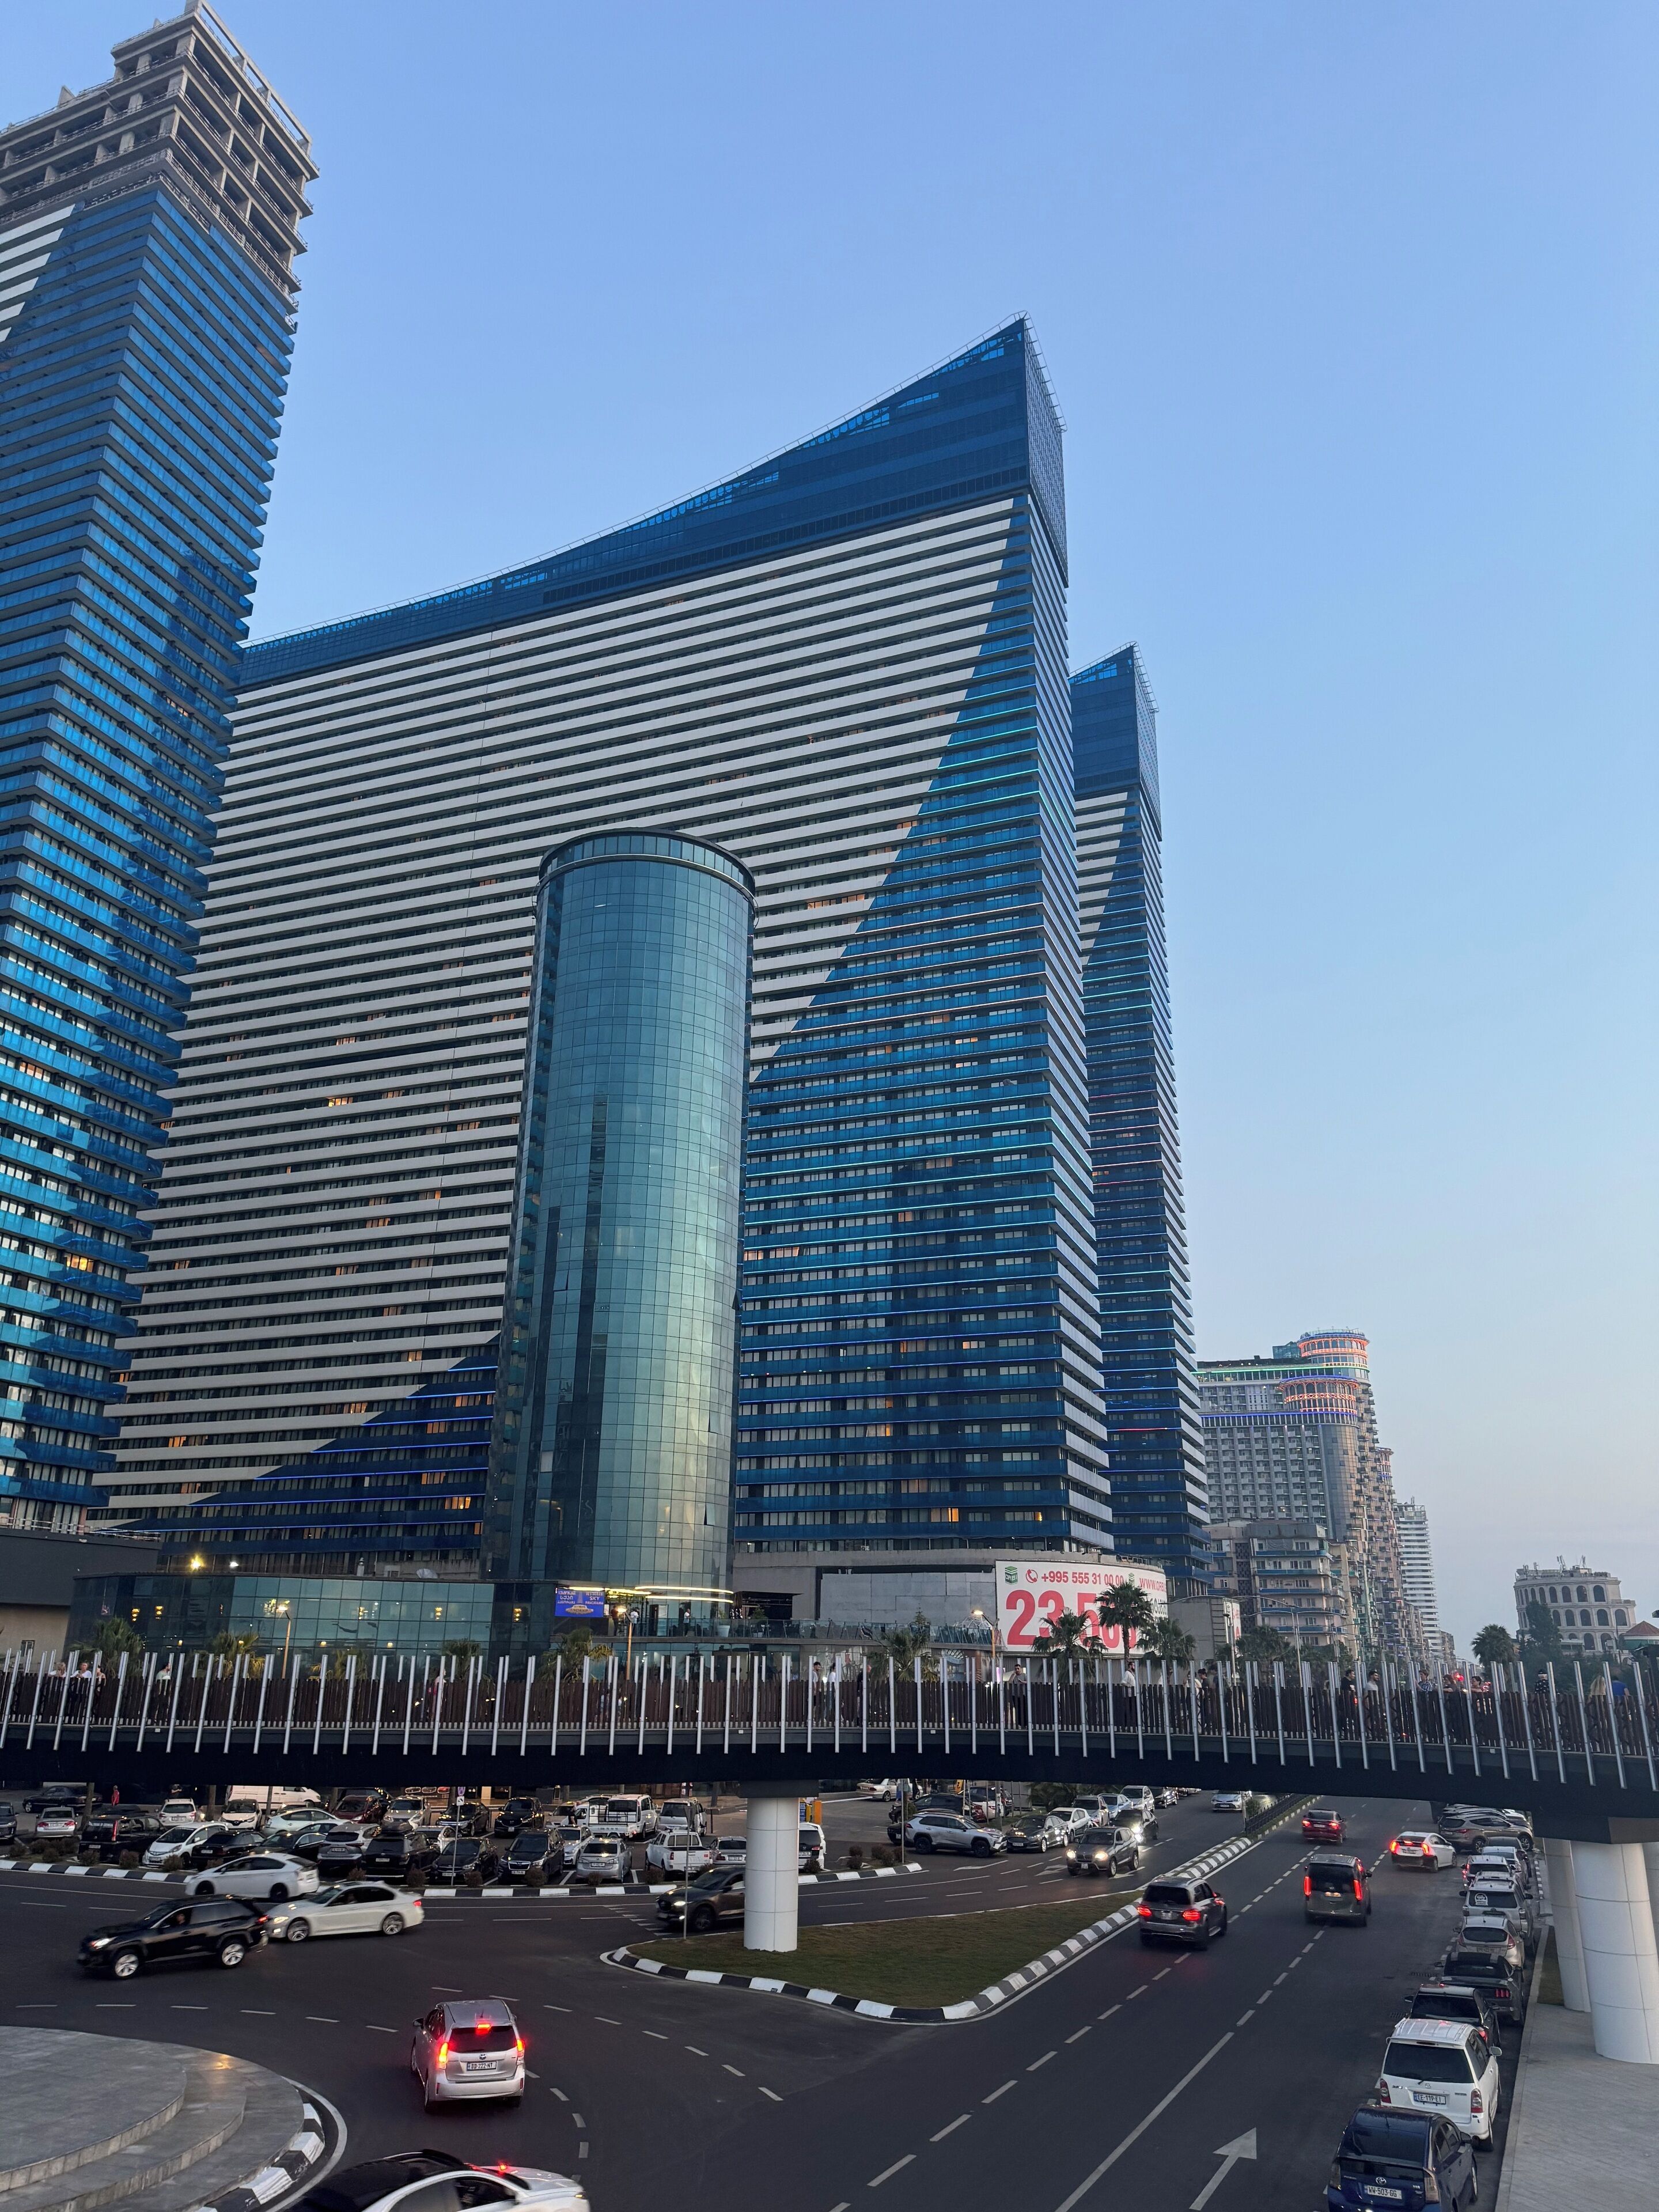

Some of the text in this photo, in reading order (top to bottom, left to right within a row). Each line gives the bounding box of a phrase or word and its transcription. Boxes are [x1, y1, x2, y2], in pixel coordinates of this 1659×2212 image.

[1041, 1571, 1069, 1582] +995
[1072, 1572, 1089, 1584] 555
[1092, 1573, 1101, 1585] 31
[1104, 1574, 1114, 1585] 00
[1116, 1575, 1124, 1586] 00
[1006, 1590, 1065, 1645] 23
[1368, 2186, 1397, 2197] WW-503-GG
